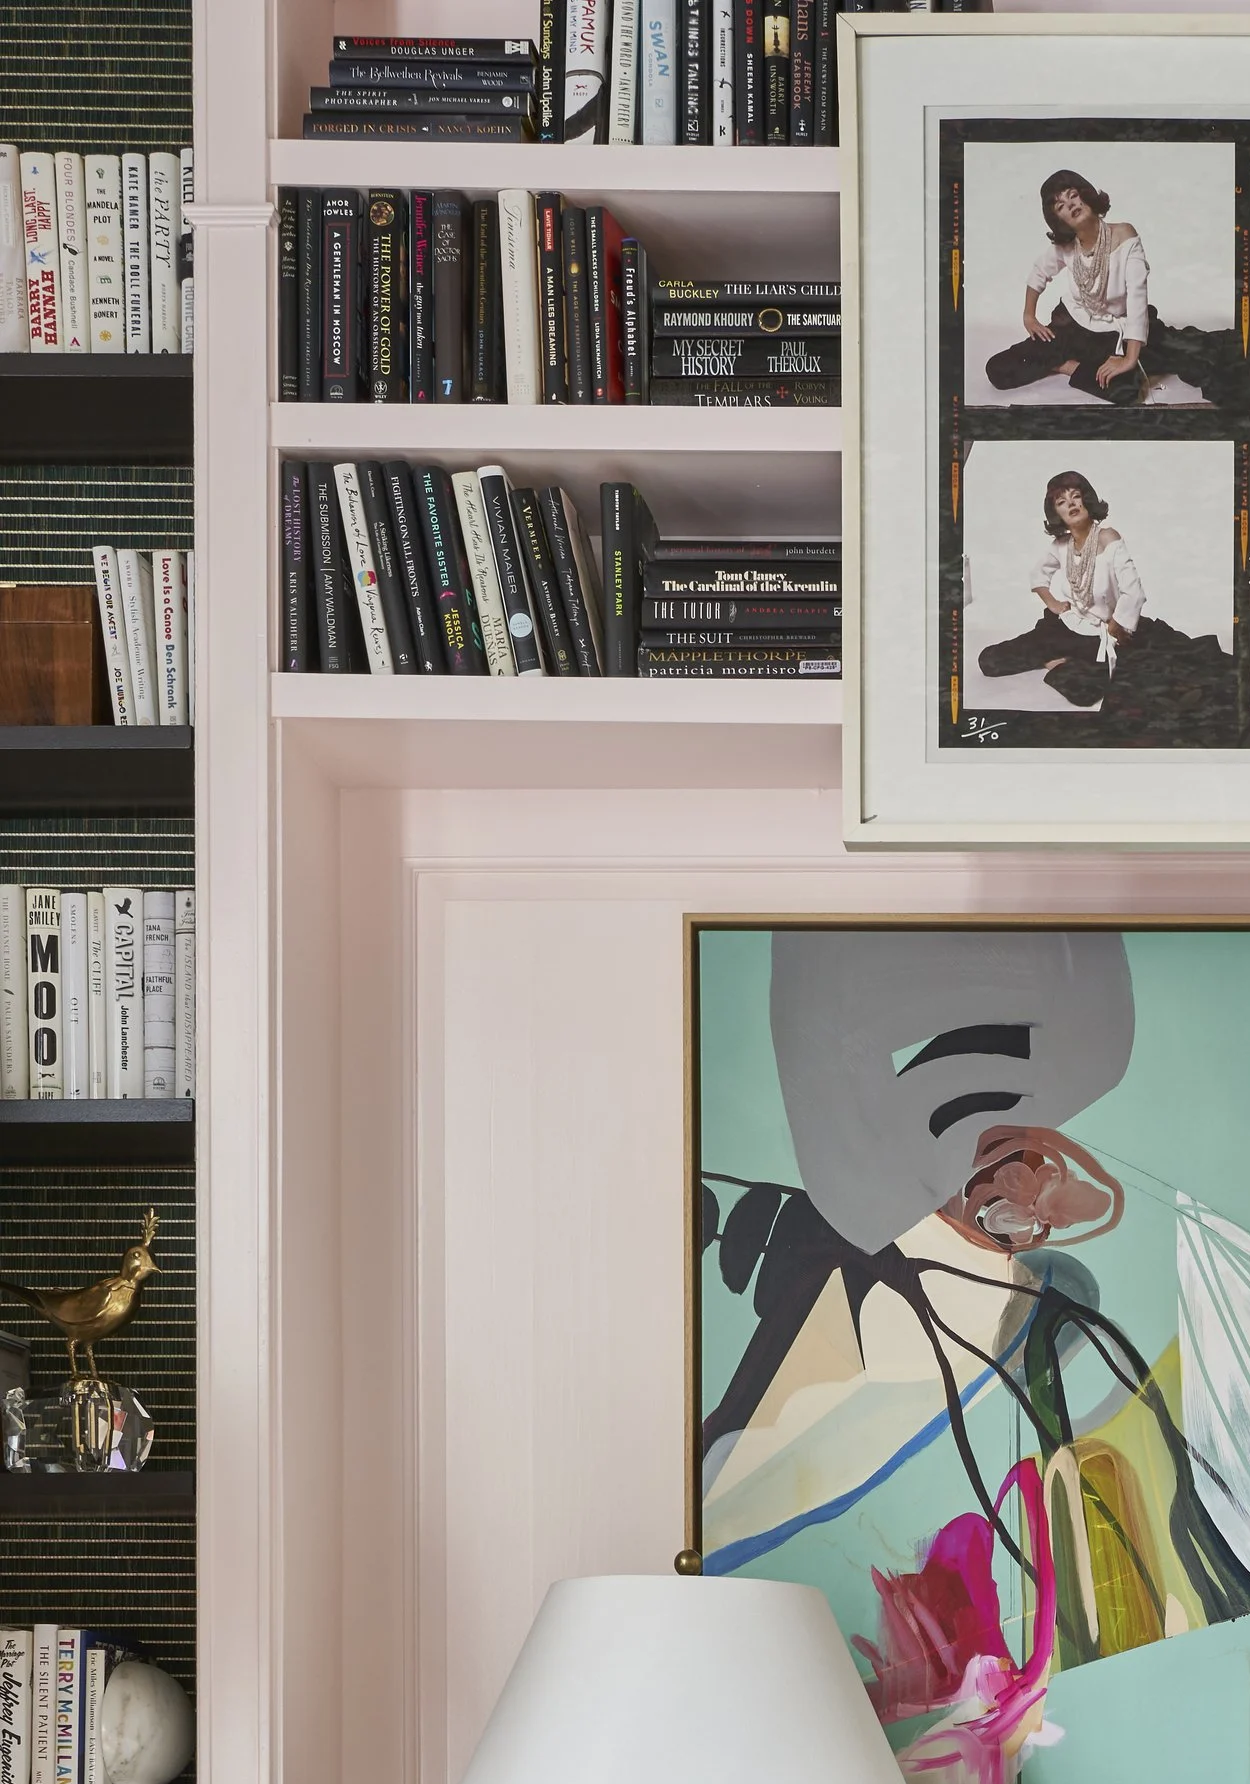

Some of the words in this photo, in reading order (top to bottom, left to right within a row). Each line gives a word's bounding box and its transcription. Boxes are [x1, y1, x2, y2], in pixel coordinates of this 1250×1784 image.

[391, 46, 437, 55] DOUGLAS
[441, 47, 474, 55] UNGER
[541, 21, 553, 59] Sundays
[649, 21, 669, 77] SWAN
[542, 66, 552, 89] John
[325, 98, 398, 106] PHOTOGRAPHER
[540, 90, 552, 127] Updike
[313, 124, 358, 132] FORGED
[380, 125, 416, 133] CRISIS
[64, 157, 73, 186] FOUR
[66, 191, 75, 241] BLONDES
[87, 202, 119, 210] MANDELA
[381, 234, 391, 261] THE
[333, 243, 341, 300] GENTLEMAN
[380, 264, 391, 312] POWER
[670, 290, 719, 298] BUCKLEY
[29, 279, 42, 339] BARRY
[41, 270, 57, 345] HANNAH
[333, 305, 340, 315] IN
[664, 313, 710, 326] RAYMOND
[714, 313, 754, 326] KHOURY
[380, 316, 390, 334] OF
[333, 320, 341, 365] MOSCOW
[380, 337, 390, 374] GOLD
[548, 319, 556, 366] DREAMING
[673, 340, 694, 356] MY
[697, 340, 744, 356] SECRET
[781, 342, 807, 356] PAUL
[682, 357, 736, 375] HISTORY
[768, 357, 821, 372] THEROUX
[318, 483, 327, 502] THE
[423, 473, 433, 493] THE
[319, 505, 332, 564] SUBMISSION
[427, 497, 442, 547] FAVORITE
[522, 506, 541, 561] VERMEER
[493, 496, 507, 544] VIVIAN
[503, 549, 517, 595] MAIER
[162, 558, 171, 583] Love
[437, 551, 449, 587] SISTER
[615, 551, 623, 589] STANLEY
[715, 571, 742, 581] Tom
[744, 571, 787, 582] Clancy
[164, 586, 172, 595] Is
[164, 607, 173, 640] Canoe
[654, 602, 674, 619] THE
[684, 603, 720, 619] TUTOR
[444, 614, 454, 647] KNOLL
[451, 608, 464, 649] JESSICA
[667, 633, 696, 643] THE
[700, 633, 733, 643] SUIT
[165, 645, 175, 664] Ben
[167, 668, 176, 708] Schrank
[968, 717, 985, 729] 31
[33, 896, 55, 909] JANE
[29, 911, 60, 925] SMILEY
[114, 925, 135, 1002] CAPITAL
[30, 935, 59, 1066] MOO
[120, 1005, 129, 1025] John
[40, 1645, 49, 1666] THE
[57, 1639, 74, 1694] TERRY
[38, 1670, 48, 1710] SILENT
[37, 1714, 47, 1760] PATIENT
